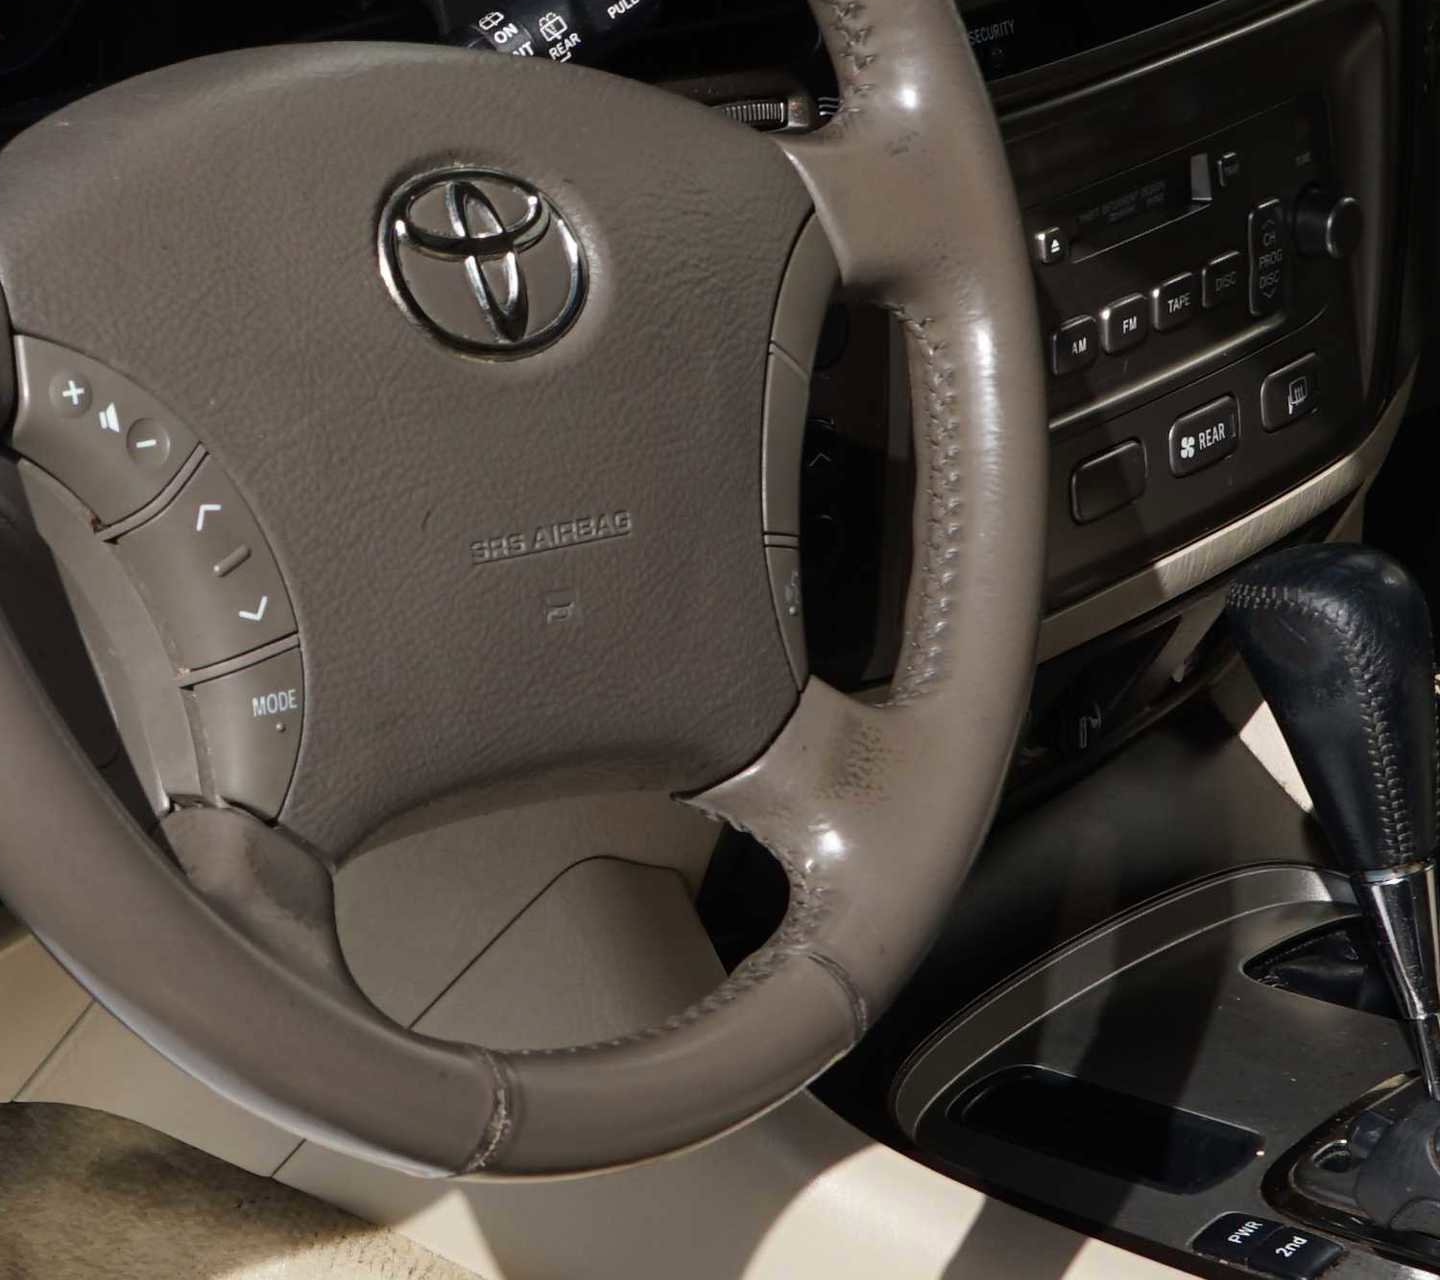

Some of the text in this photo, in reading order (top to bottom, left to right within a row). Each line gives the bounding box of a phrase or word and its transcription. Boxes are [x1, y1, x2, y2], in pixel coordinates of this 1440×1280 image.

[494, 22, 518, 44] ON
[968, 17, 1015, 46] SECURITY
[548, 32, 581, 60] REAR
[1215, 271, 1237, 291] DISC
[1167, 292, 1192, 313] TAPE
[1122, 315, 1137, 334] FM
[1071, 336, 1087, 356] AM
[1199, 422, 1226, 451] REAR
[471, 510, 633, 560] SRS AIRBAG
[251, 688, 298, 717] MODE
[1227, 1220, 1263, 1244] PWR
[1275, 1235, 1308, 1258] 2nd
